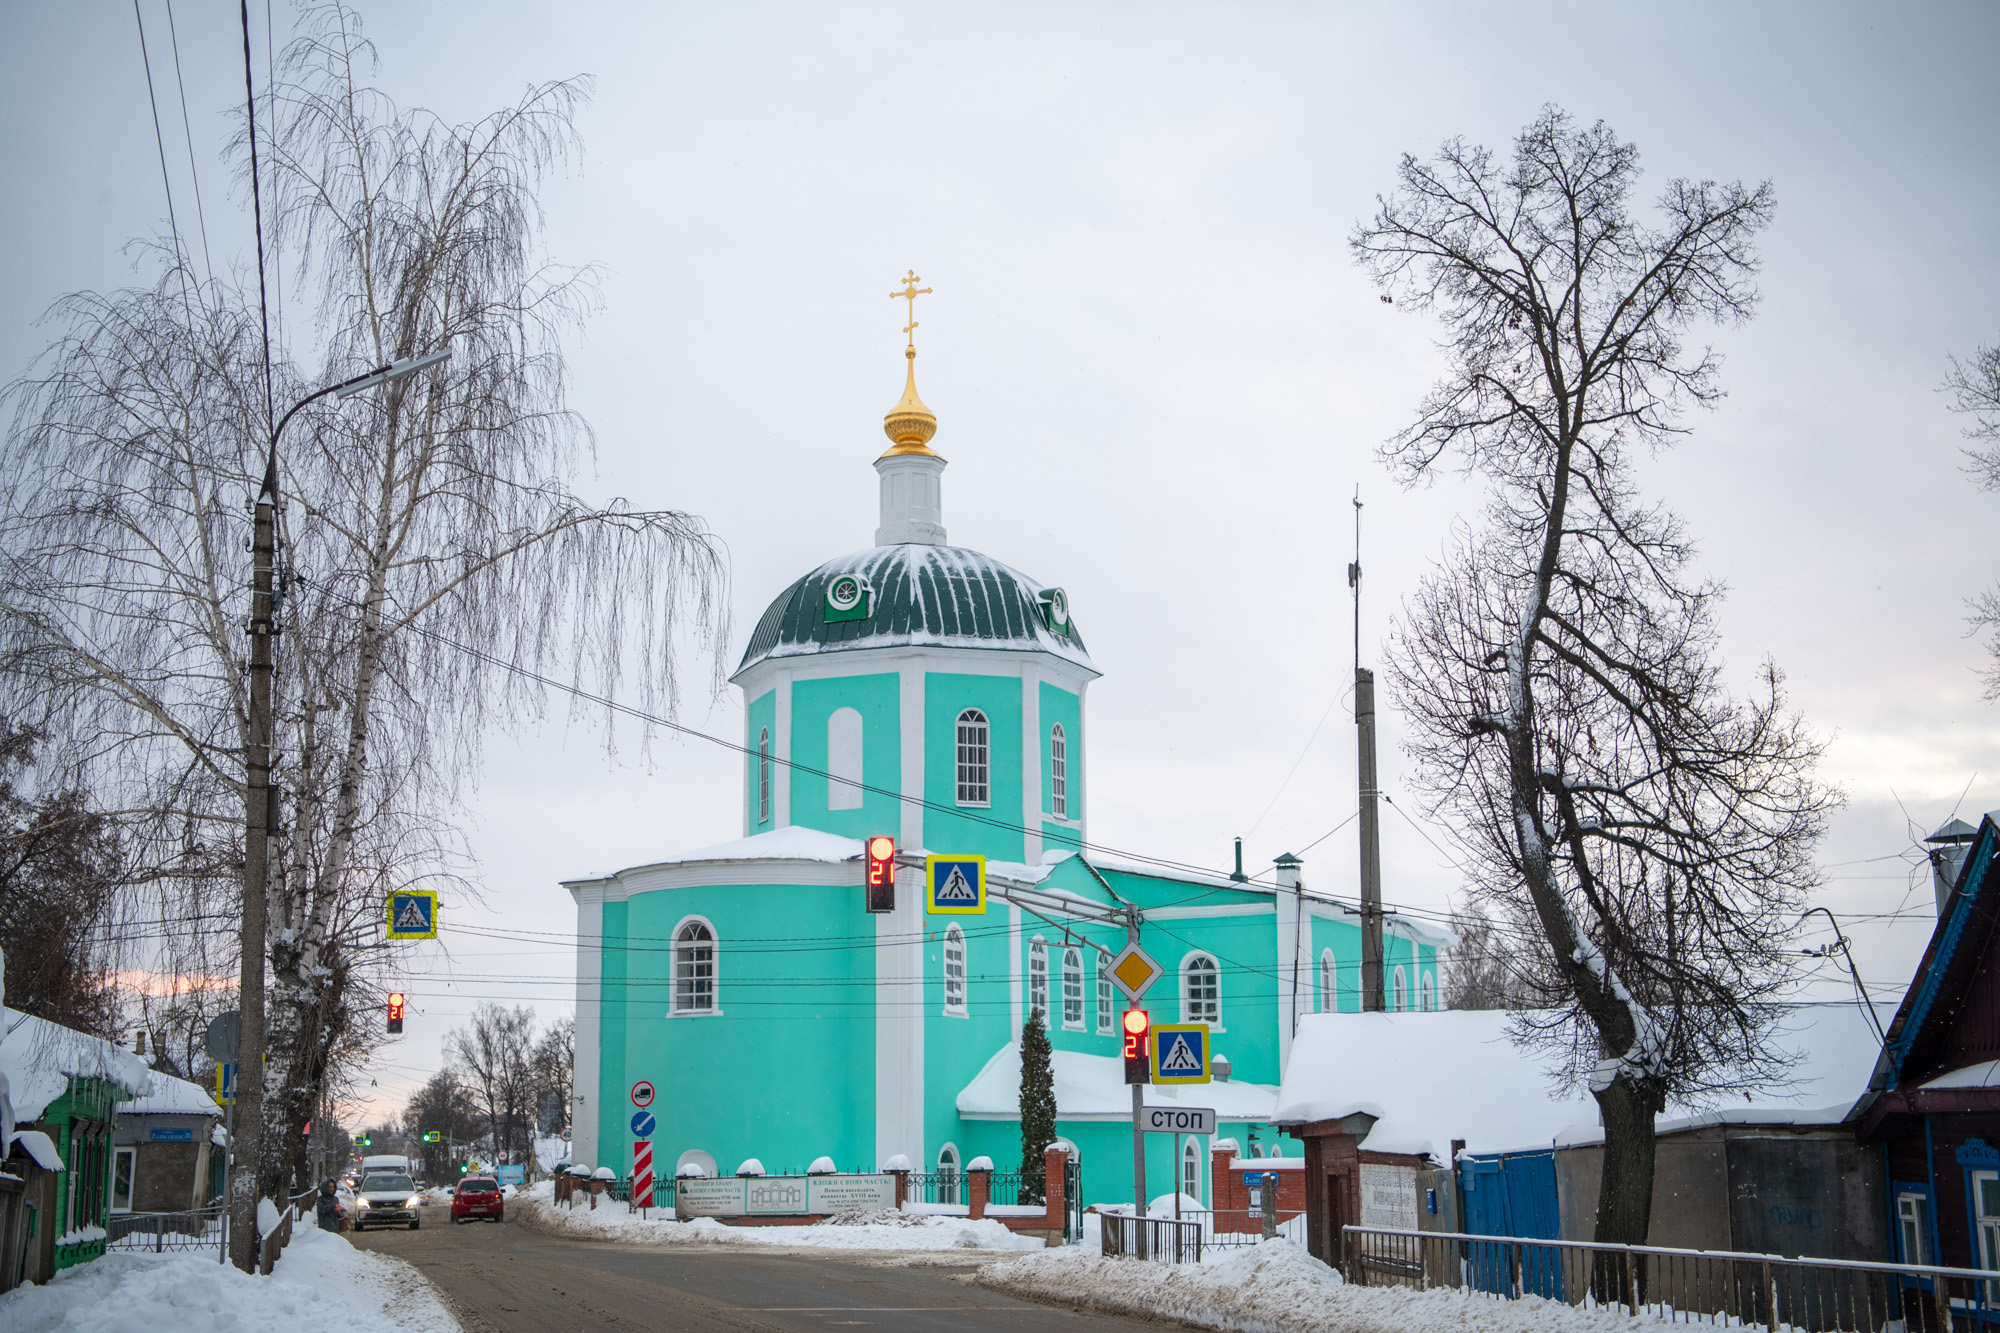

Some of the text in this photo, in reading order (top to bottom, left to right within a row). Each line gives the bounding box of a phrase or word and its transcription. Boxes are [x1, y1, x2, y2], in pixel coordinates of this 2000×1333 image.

[870, 861, 895, 885] 21
[390, 1007, 403, 1019] 21
[1125, 1036, 1149, 1058] 21
[1151, 1111, 1203, 1129] СТОП
[562, 1130, 572, 1138] 40
